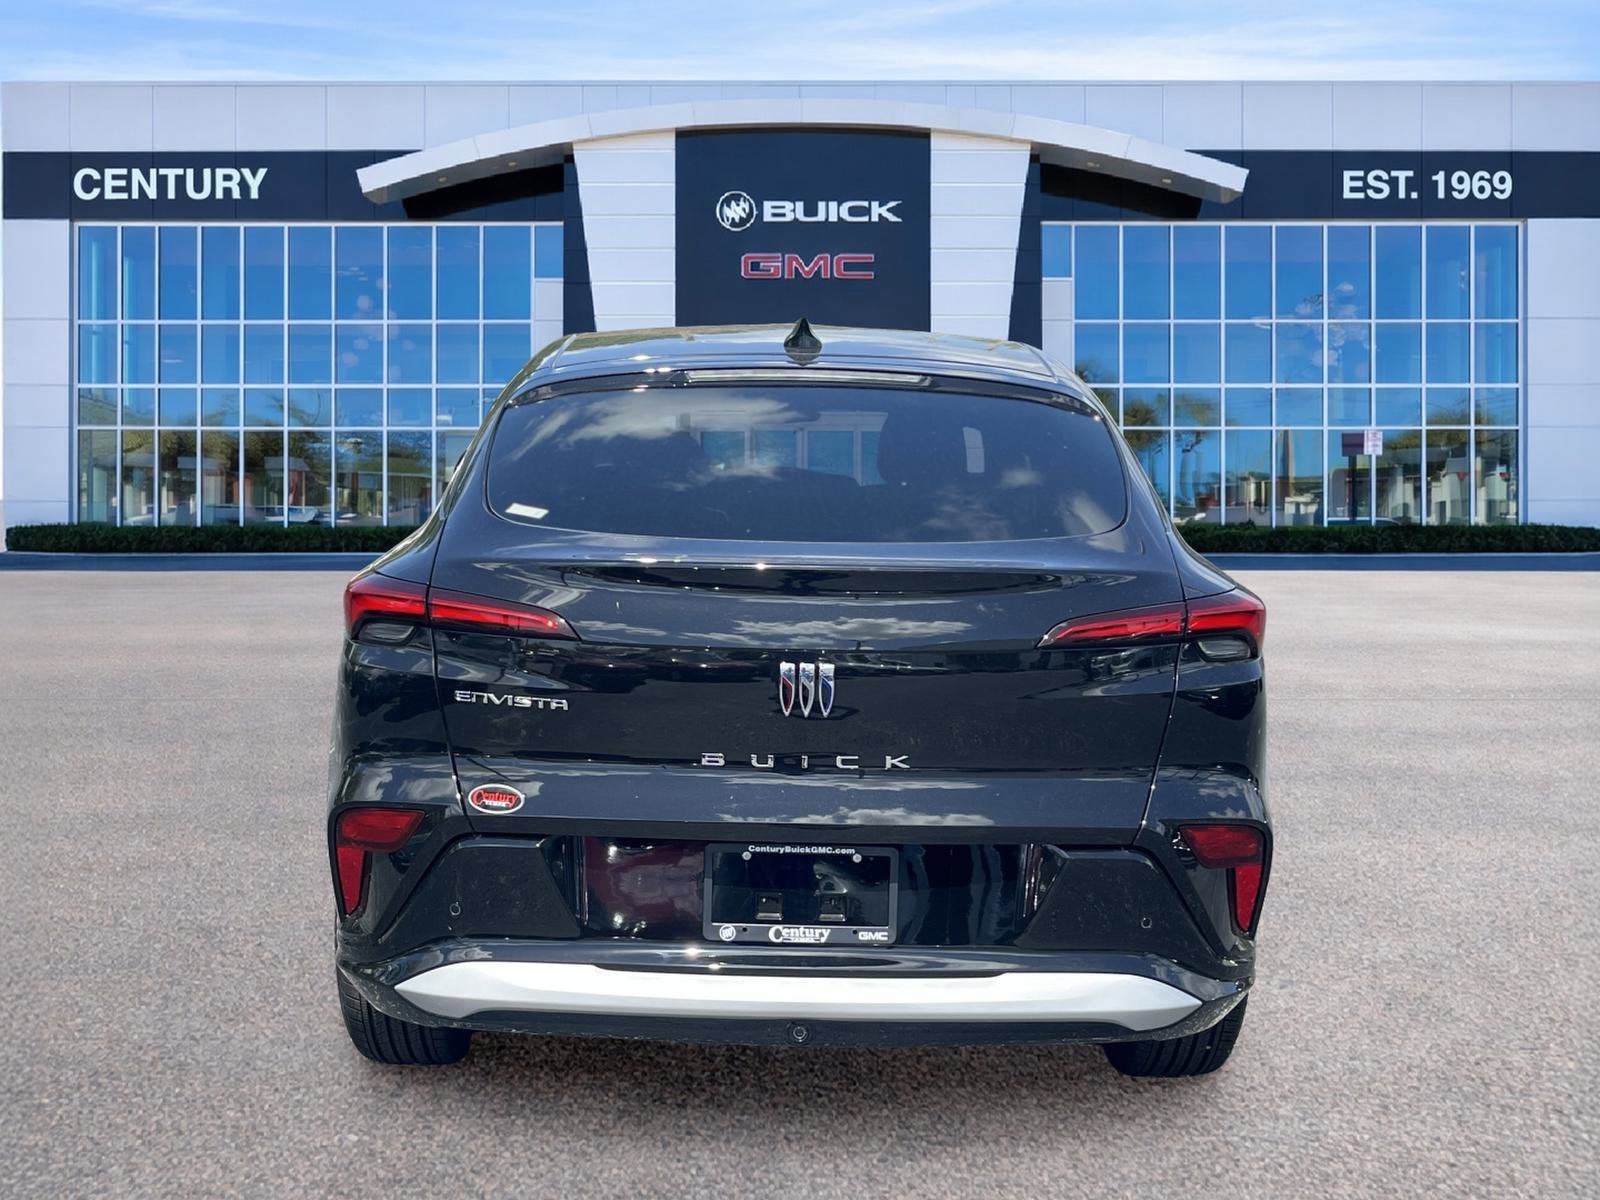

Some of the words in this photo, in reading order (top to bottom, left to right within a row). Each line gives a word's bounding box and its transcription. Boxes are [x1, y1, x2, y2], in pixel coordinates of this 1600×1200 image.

[73, 167, 268, 200] CENTURY
[1342, 169, 1418, 200] EST.
[1431, 170, 1513, 200] 1969
[763, 200, 903, 222] BUICK
[741, 252, 875, 279] GMC
[454, 690, 569, 711] ENVISTA
[701, 752, 911, 770] BUICK
[471, 788, 518, 809] Century
[748, 845, 856, 855] CenturyBuickGMC.com
[768, 925, 831, 943] Century
[858, 931, 889, 941] GMC
